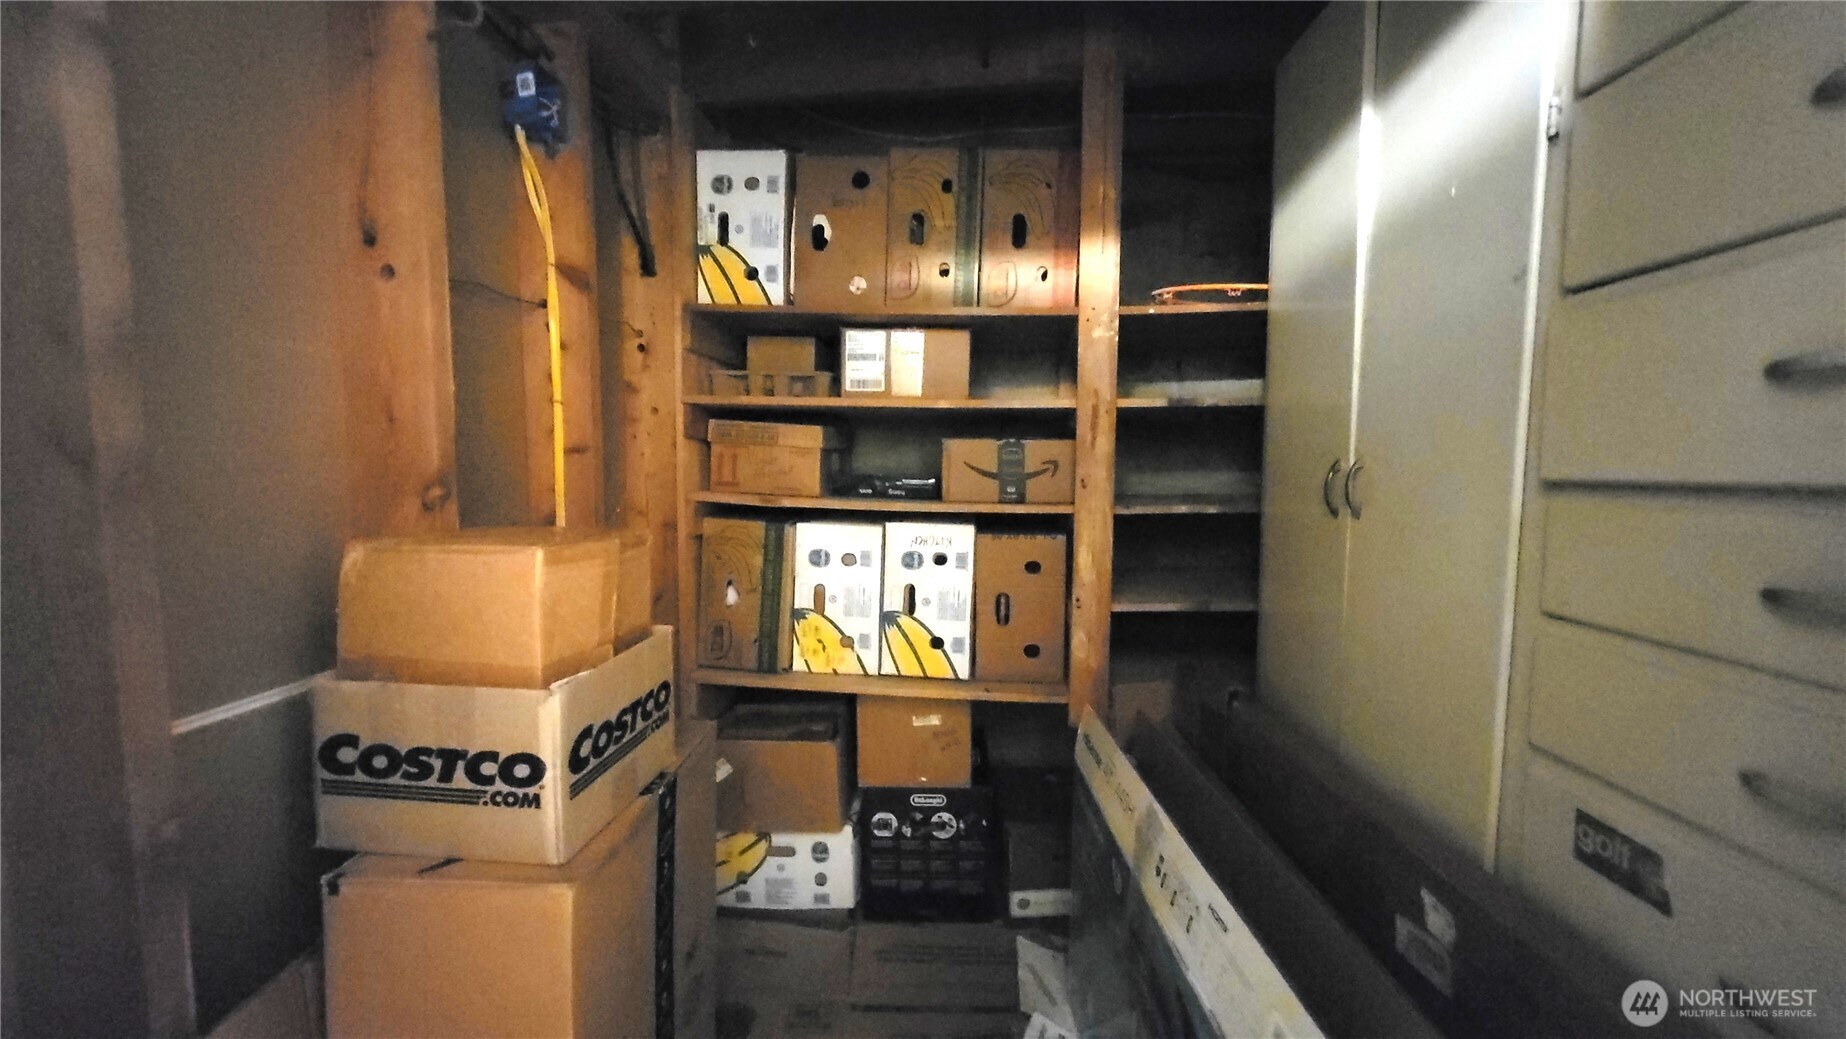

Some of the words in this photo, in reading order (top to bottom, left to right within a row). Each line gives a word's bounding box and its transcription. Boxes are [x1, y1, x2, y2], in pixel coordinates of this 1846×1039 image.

[568, 680, 671, 775] COSTCO
[318, 733, 548, 789] COSTCO
[482, 789, 542, 809] .COM
